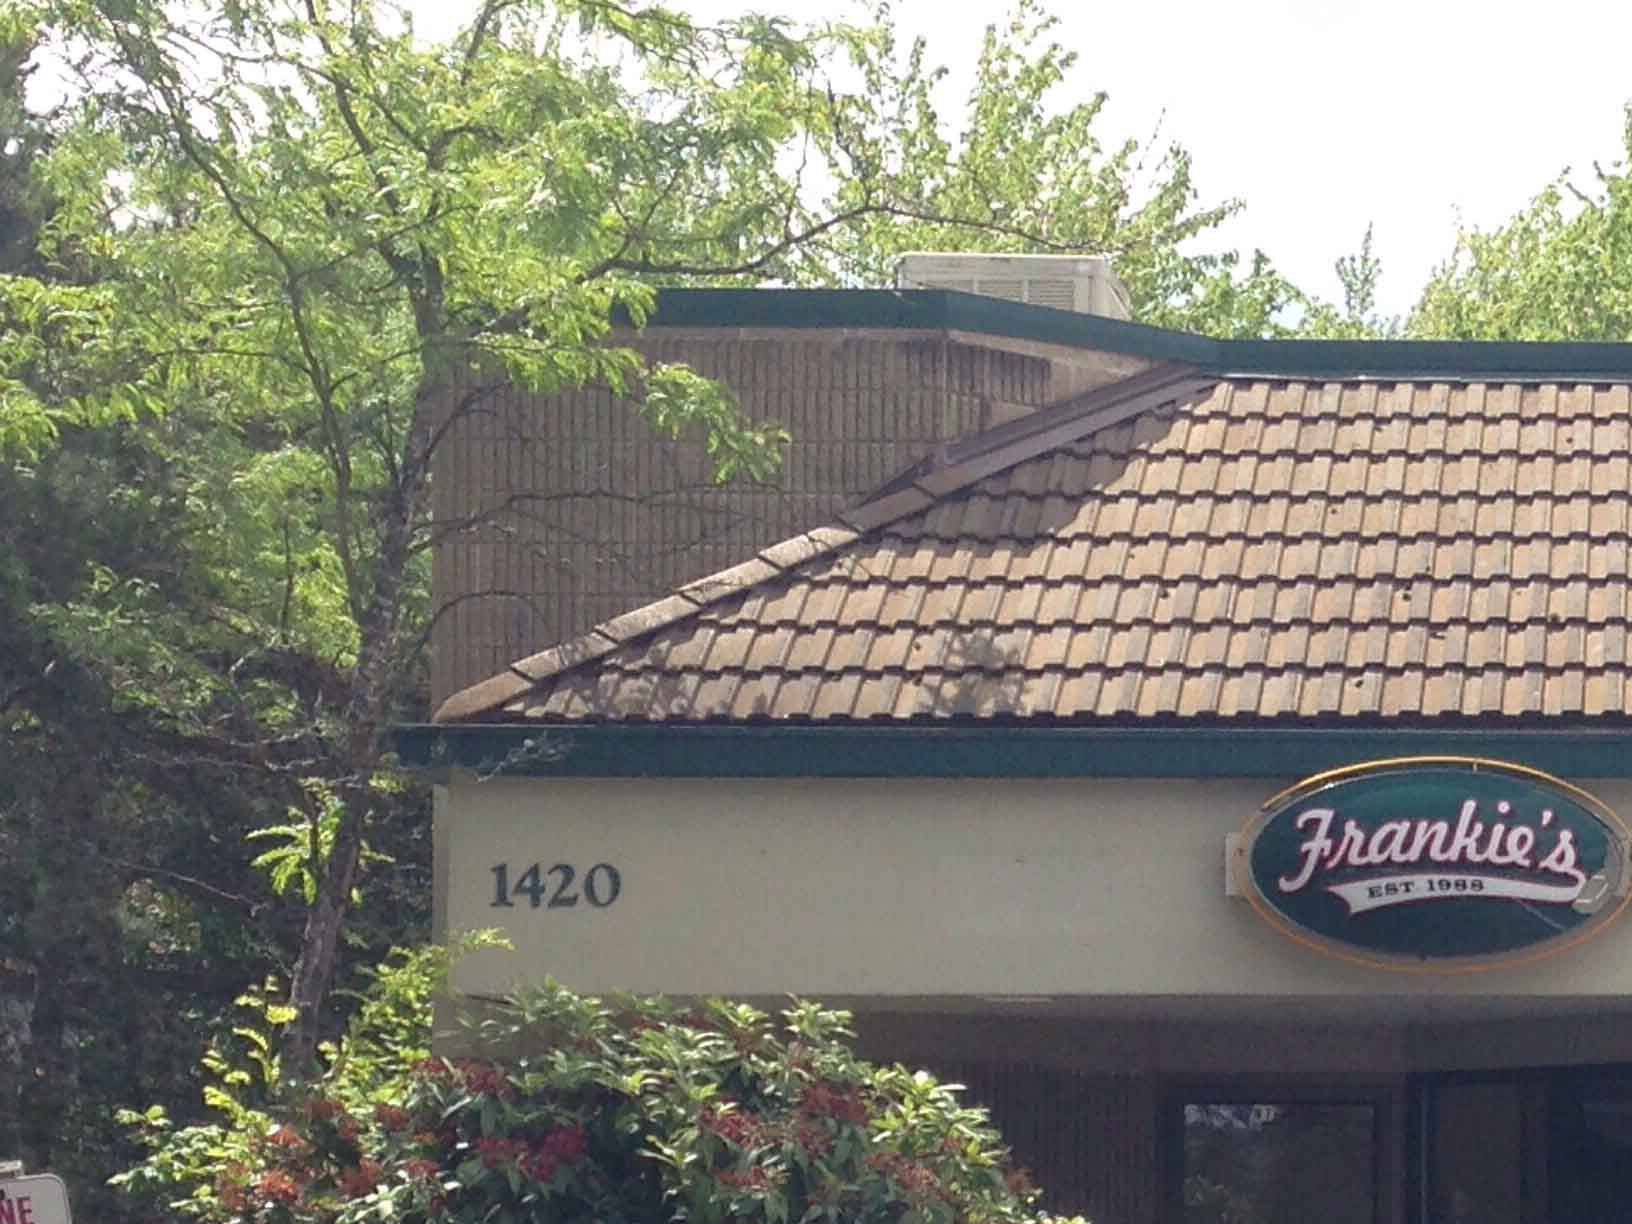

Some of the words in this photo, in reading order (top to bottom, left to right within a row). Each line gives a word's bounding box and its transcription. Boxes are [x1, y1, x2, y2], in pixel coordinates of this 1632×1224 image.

[1277, 799, 1588, 893] Frankie's
[489, 862, 621, 909] 1420
[1367, 880, 1416, 899] EST
[1426, 877, 1485, 894] 1988
